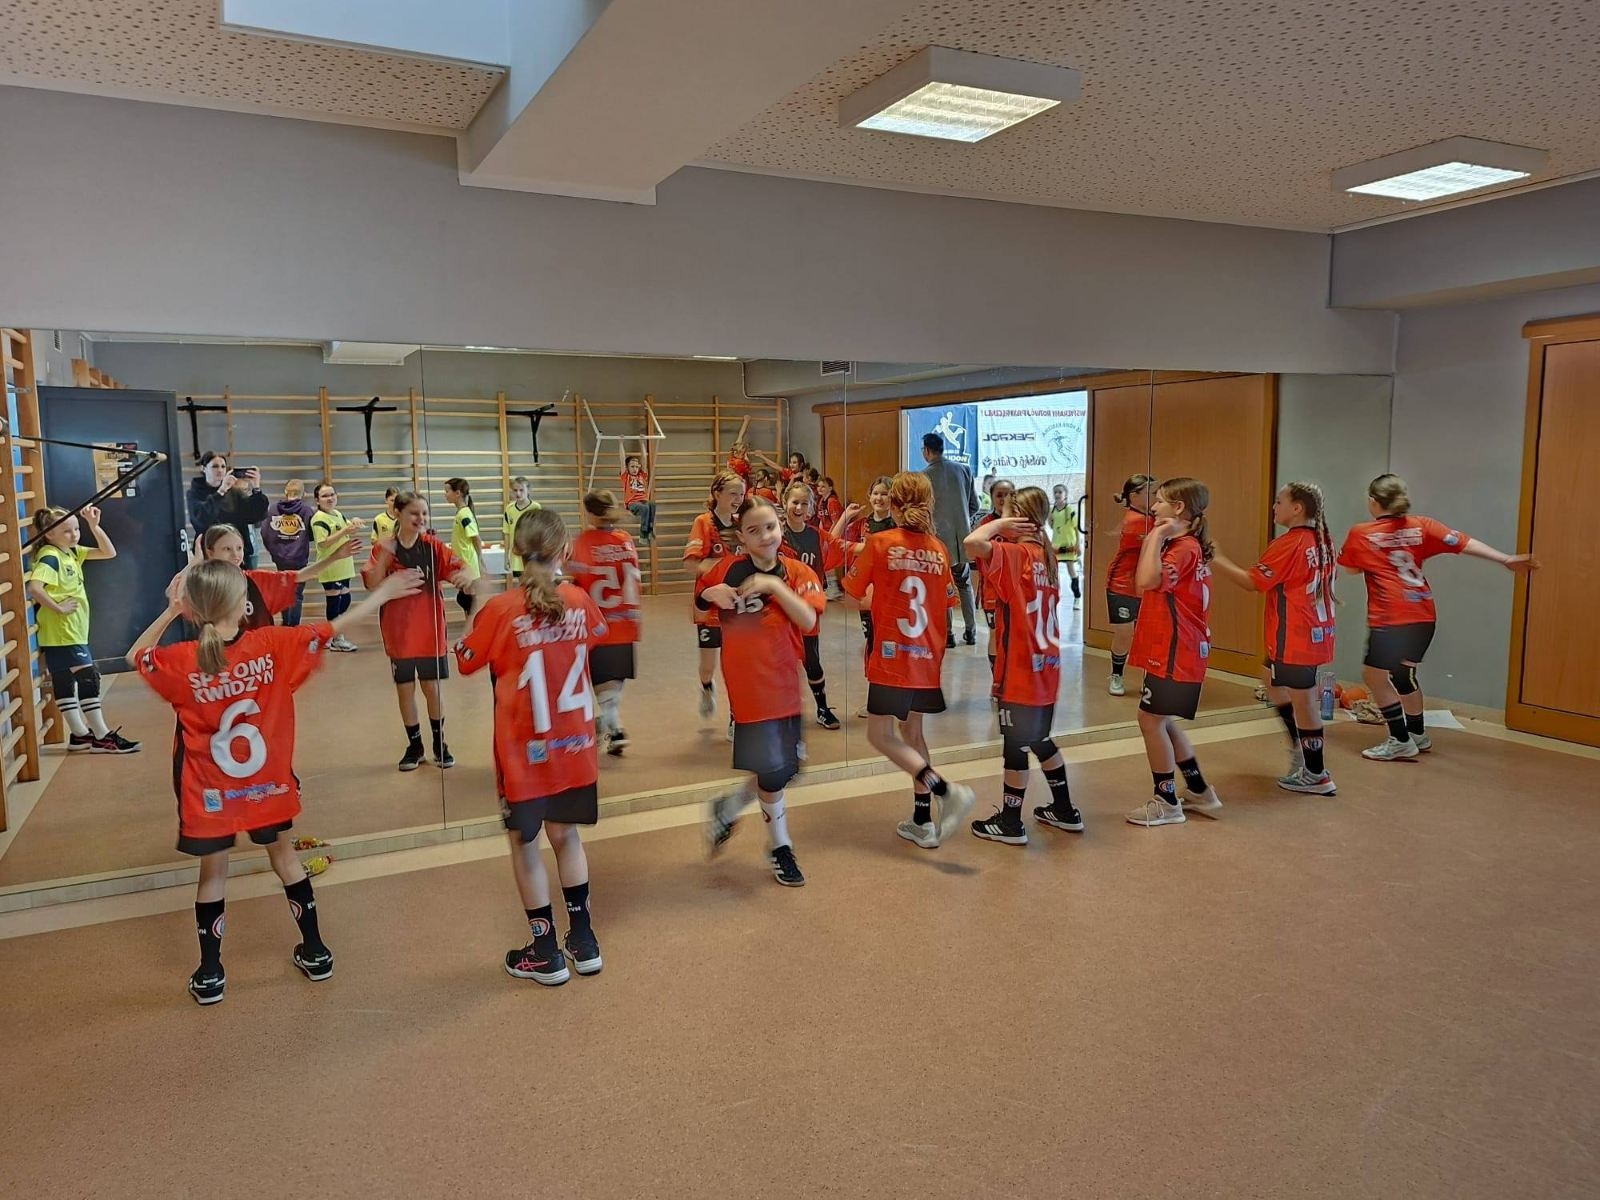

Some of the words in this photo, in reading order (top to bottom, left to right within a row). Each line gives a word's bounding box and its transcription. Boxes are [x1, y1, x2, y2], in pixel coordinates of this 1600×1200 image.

[915, 549, 944, 564] OMS
[896, 576, 928, 639] 3
[187, 672, 214, 689] SP
[233, 653, 274, 678] OMS
[518, 643, 594, 735] 14
[210, 698, 268, 779] 6
